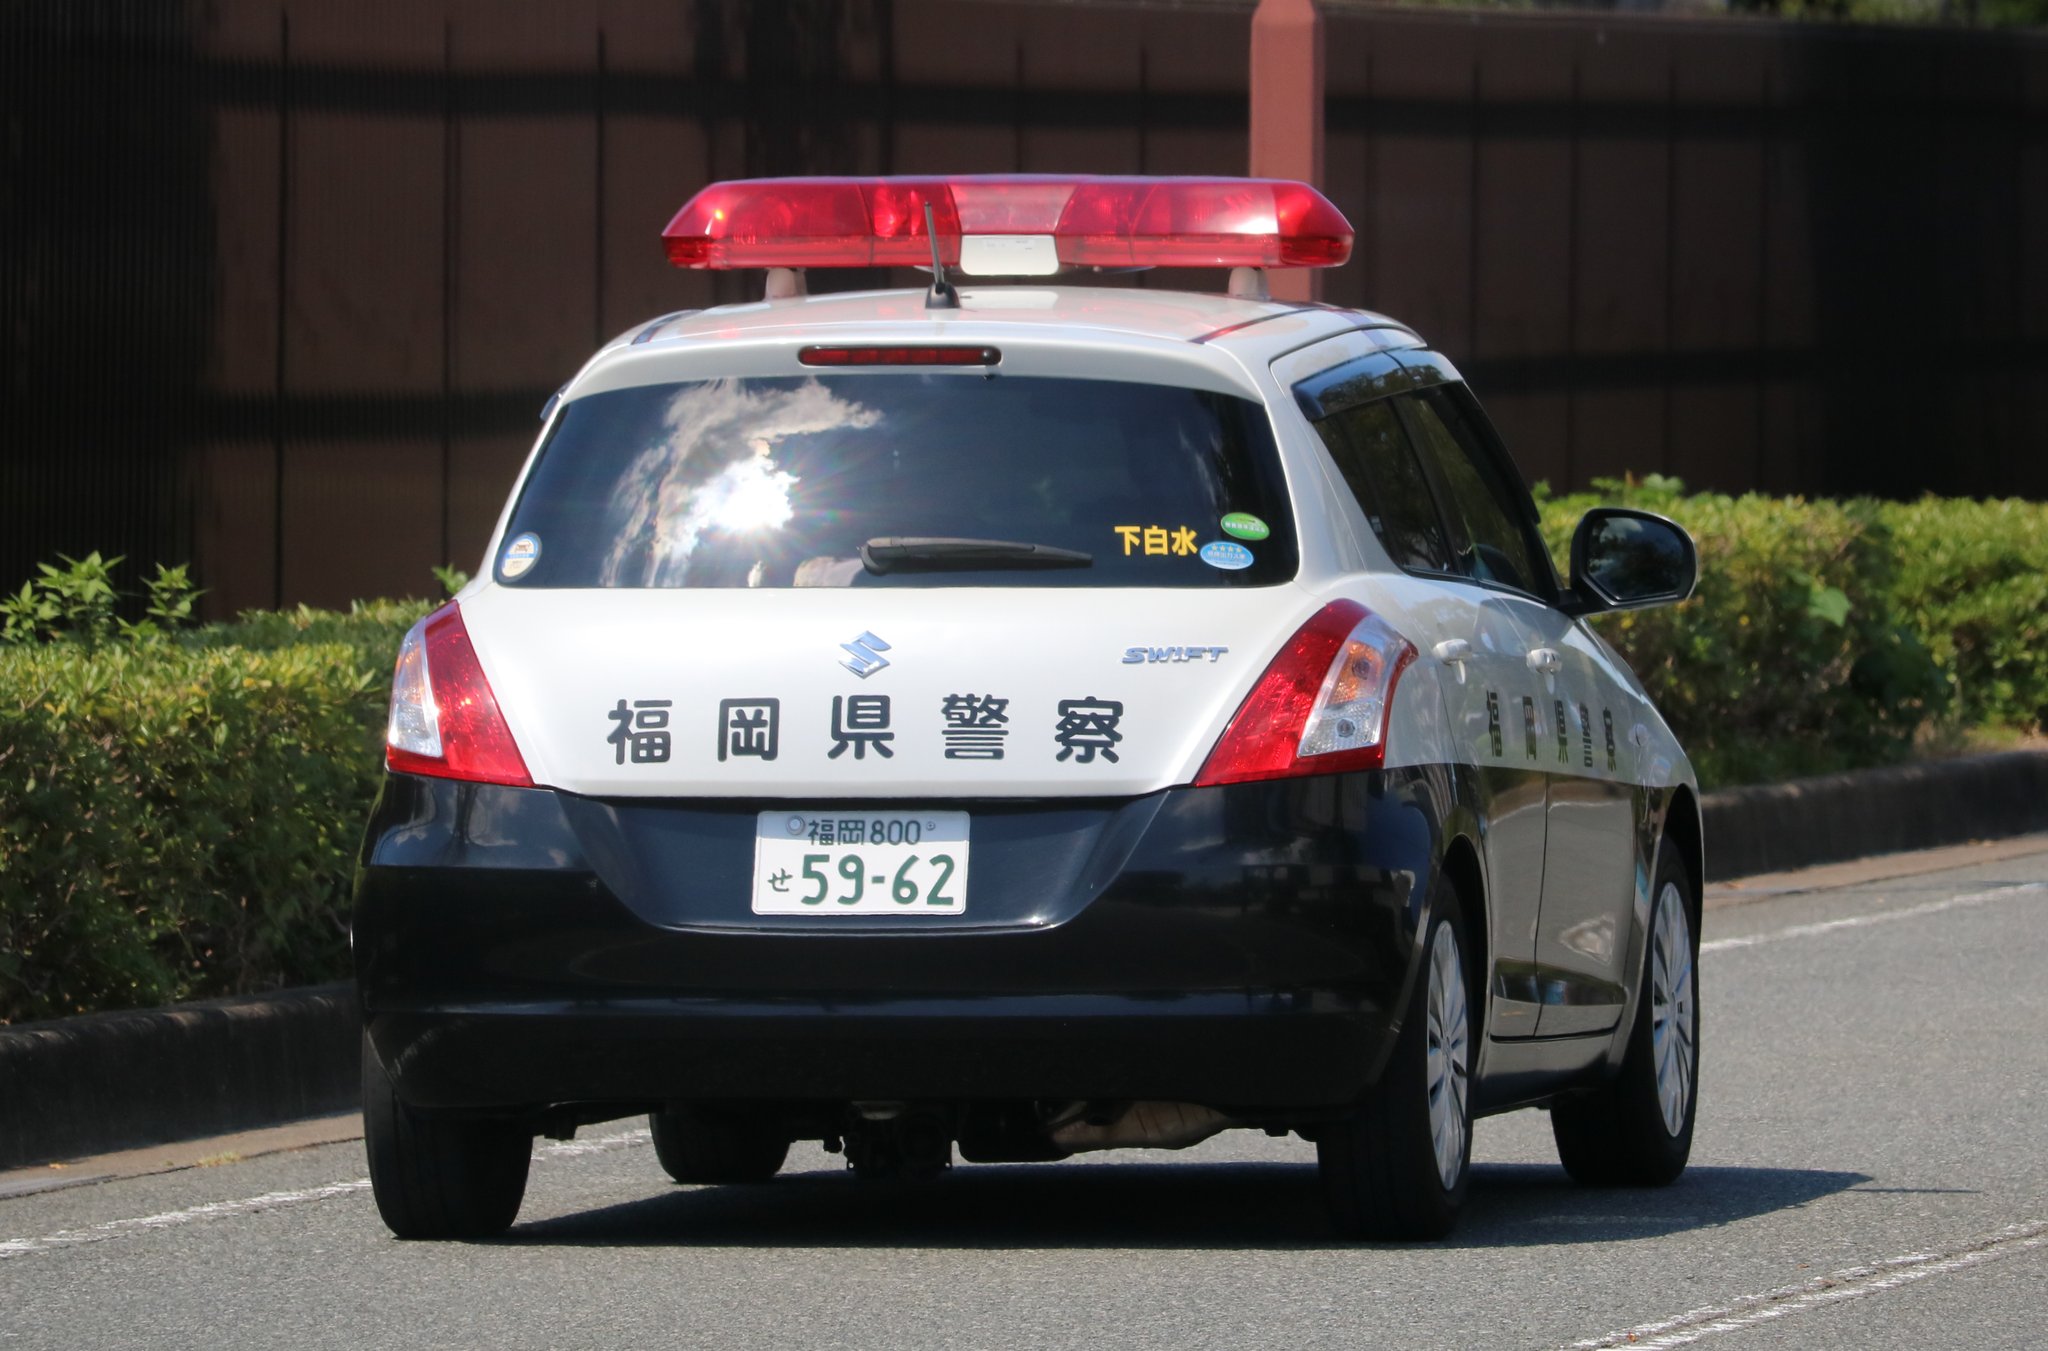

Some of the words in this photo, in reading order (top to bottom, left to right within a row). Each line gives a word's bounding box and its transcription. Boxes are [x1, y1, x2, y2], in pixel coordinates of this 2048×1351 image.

[1114, 525, 1198, 556] 下白水
[1122, 646, 1229, 664] SWIFT
[607, 693, 1123, 765] 福岡県警察
[767, 867, 793, 892] せ
[800, 854, 955, 906] 59-62
